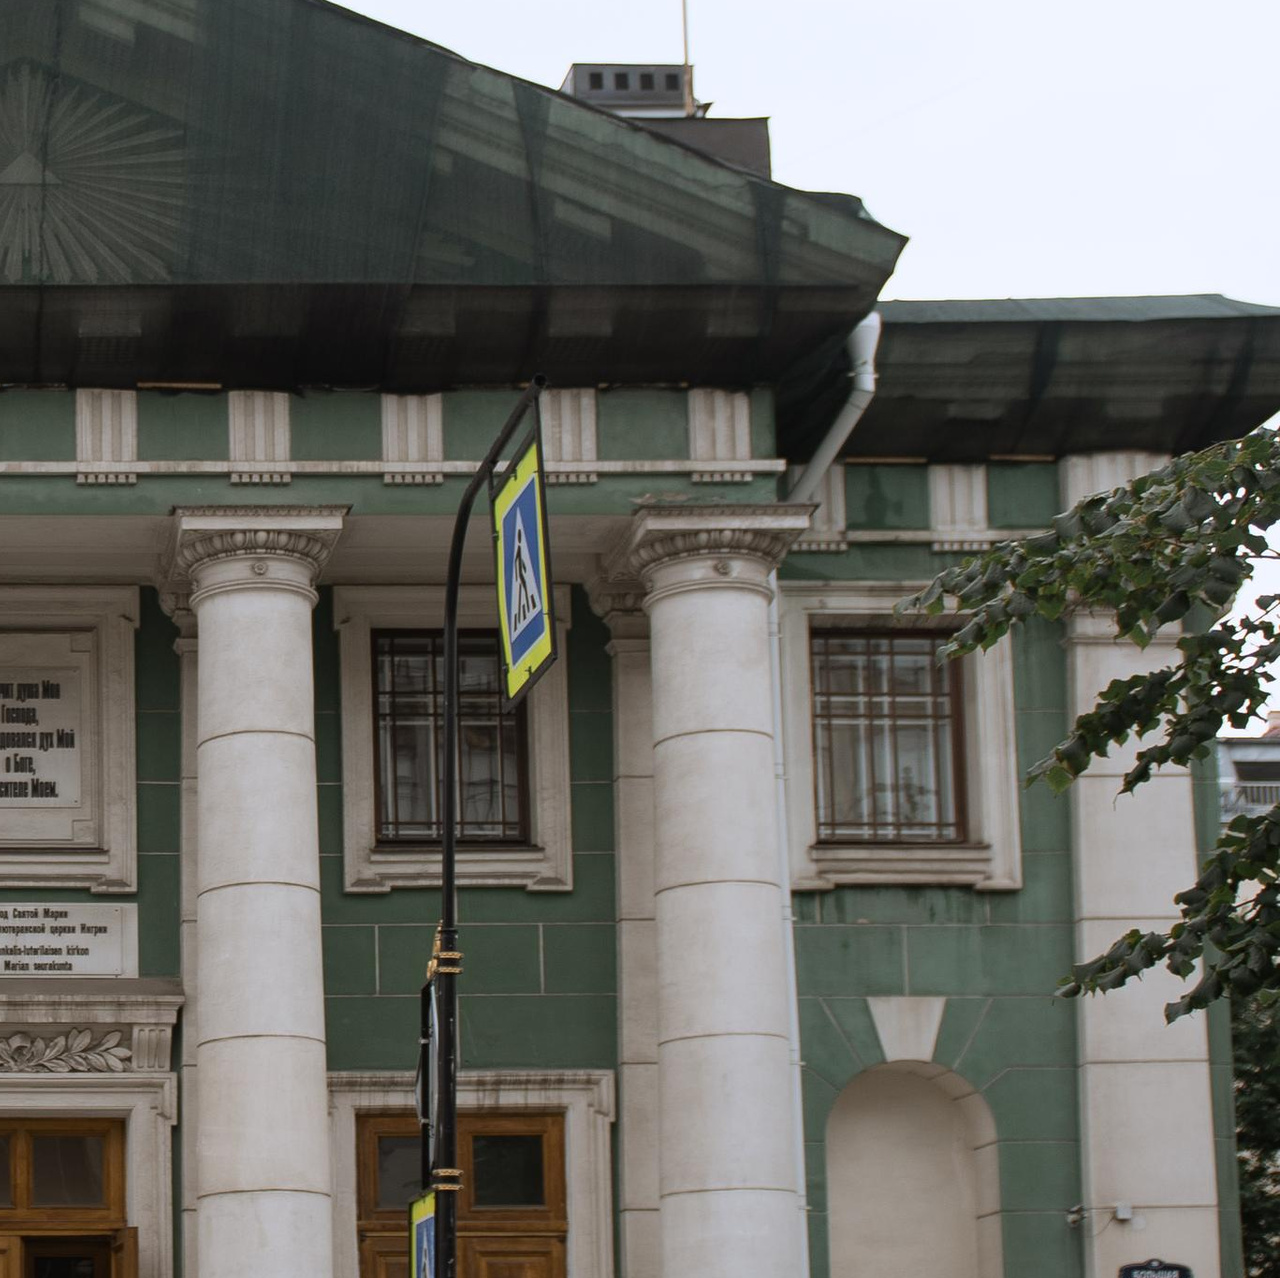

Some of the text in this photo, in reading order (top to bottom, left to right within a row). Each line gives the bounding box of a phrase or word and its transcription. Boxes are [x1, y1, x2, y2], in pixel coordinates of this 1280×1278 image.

[39, 732, 54, 751] дух
[56, 728, 75, 748] Мой
[13, 907, 38, 919] Святой
[43, 907, 68, 921] Марии
[50, 925, 76, 936] церкви
[80, 923, 107, 936] Ингрии
[66, 945, 89, 955] kirkon
[4, 960, 29, 971] Marian
[33, 961, 72, 971] seurakunta
